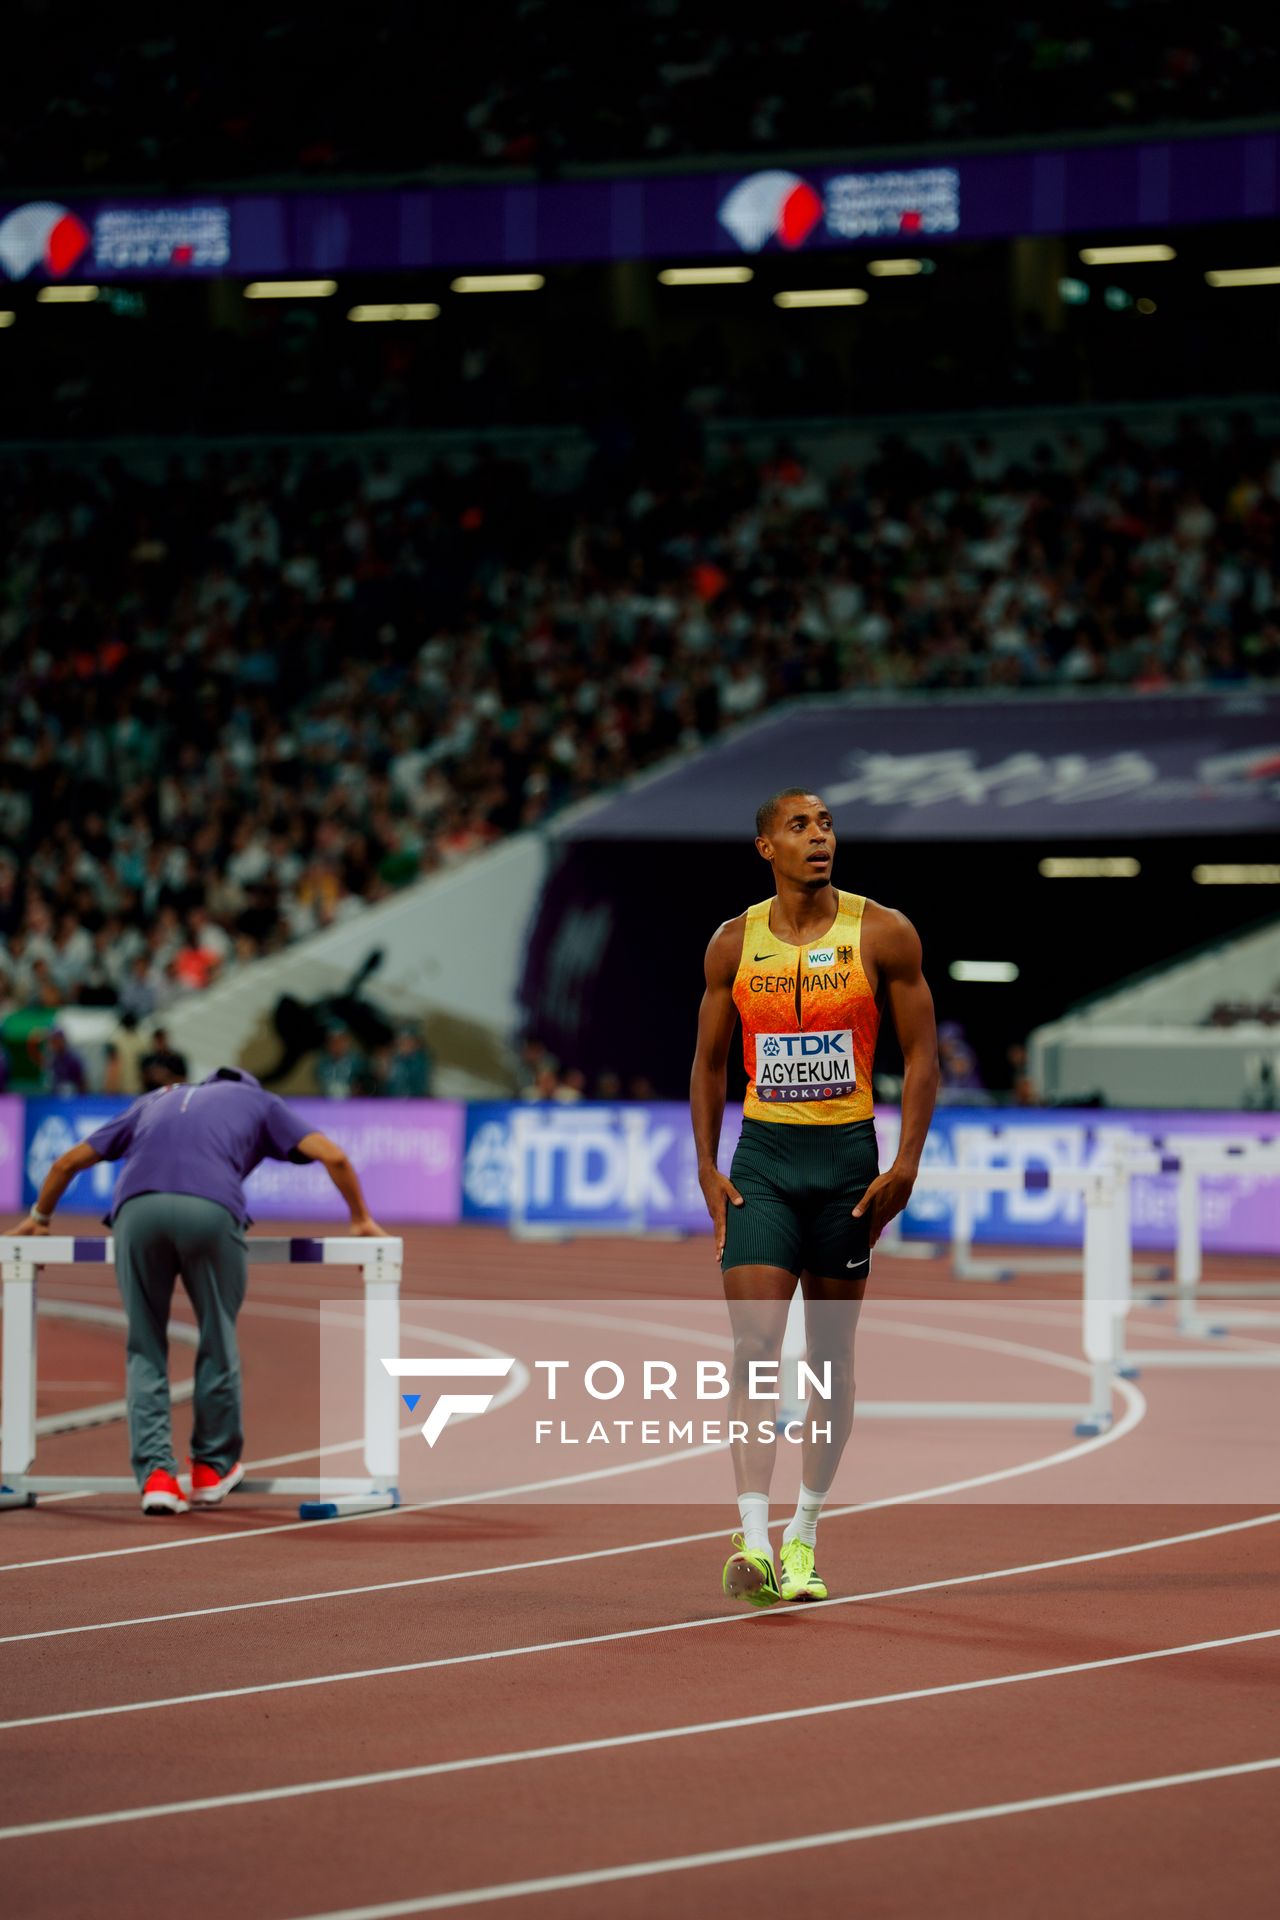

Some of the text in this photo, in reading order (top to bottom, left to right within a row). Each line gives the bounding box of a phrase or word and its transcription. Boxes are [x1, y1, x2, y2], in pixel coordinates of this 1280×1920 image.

[808, 952, 834, 963] WGV
[750, 972, 851, 993] GERMANY
[779, 1033, 845, 1056] TDK
[760, 1059, 850, 1084] AGYEKUM
